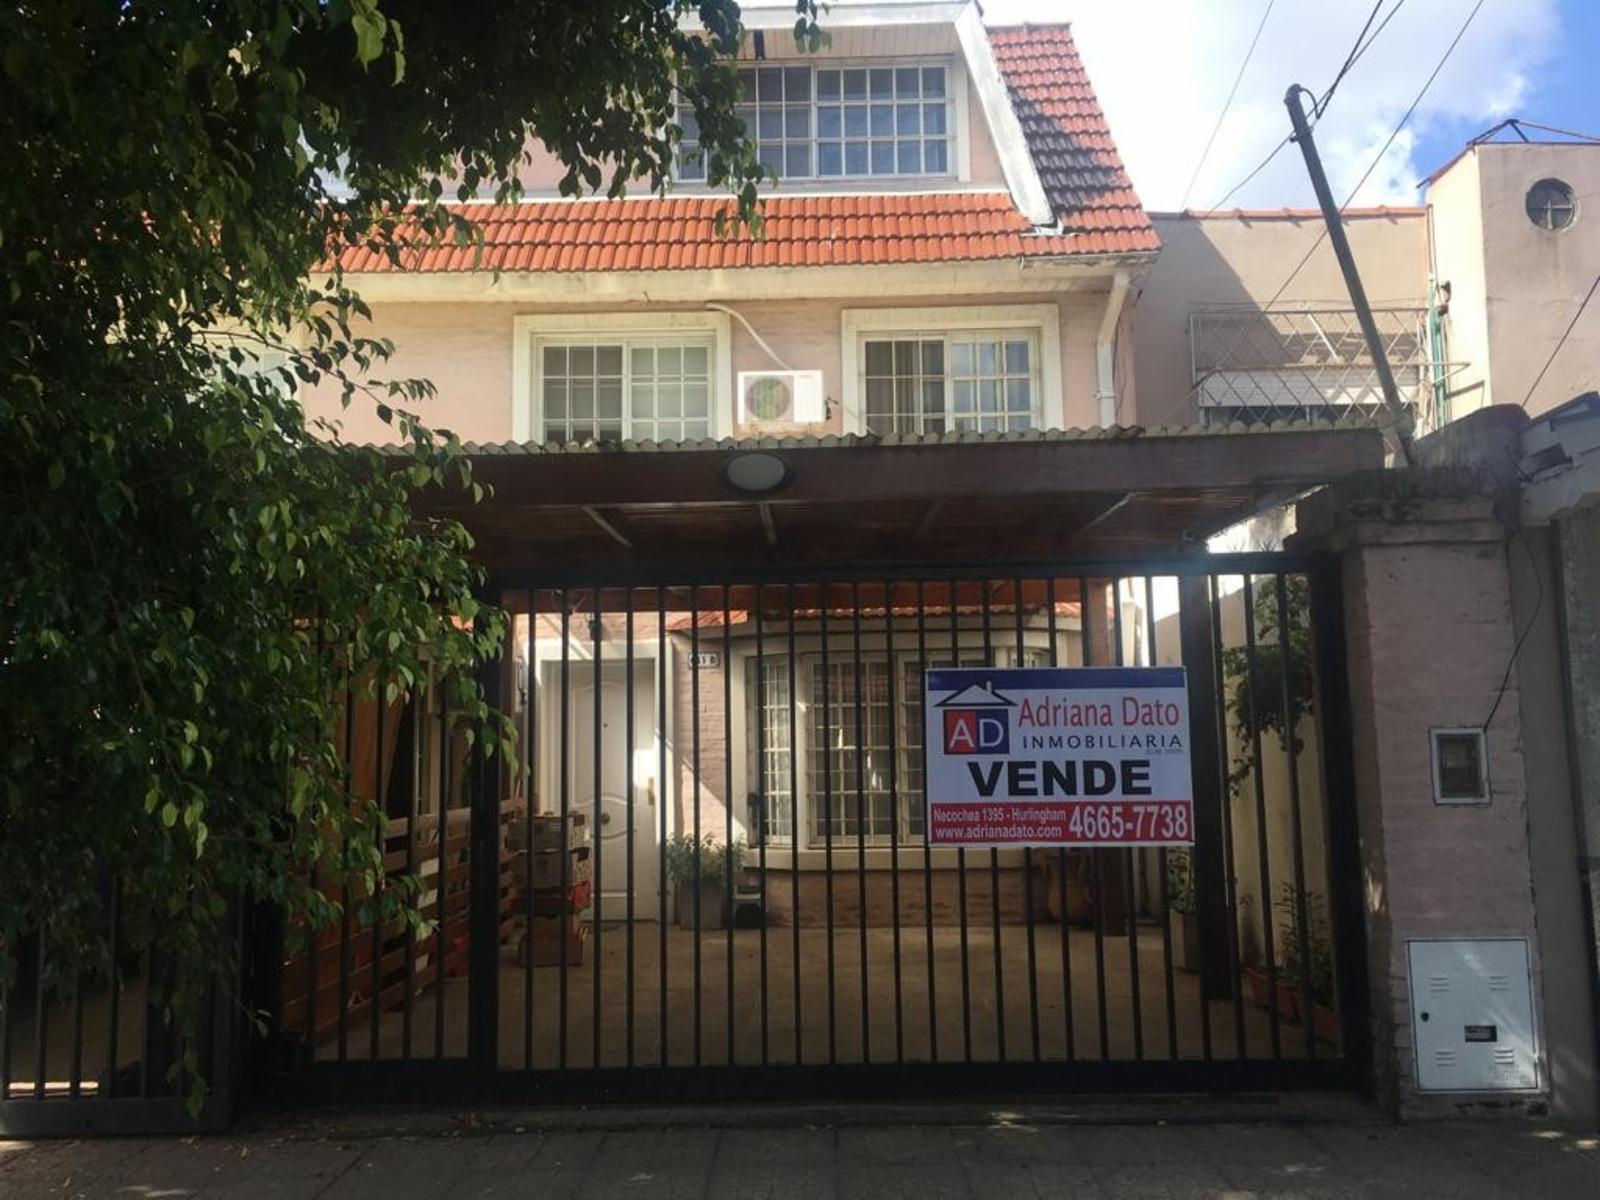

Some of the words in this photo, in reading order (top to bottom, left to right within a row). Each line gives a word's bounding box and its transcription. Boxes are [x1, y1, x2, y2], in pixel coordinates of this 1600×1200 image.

[1018, 697, 1113, 728] Adriana
[1122, 696, 1180, 727] Dato
[949, 718, 1004, 748] AD
[1023, 734, 1182, 749] INMOBILIARIA
[967, 760, 1152, 796] VENDE
[1012, 807, 1066, 824] Hurlingham
[1069, 804, 1188, 838] 4665-7738
[935, 825, 1062, 838] www.adrianadato.com
